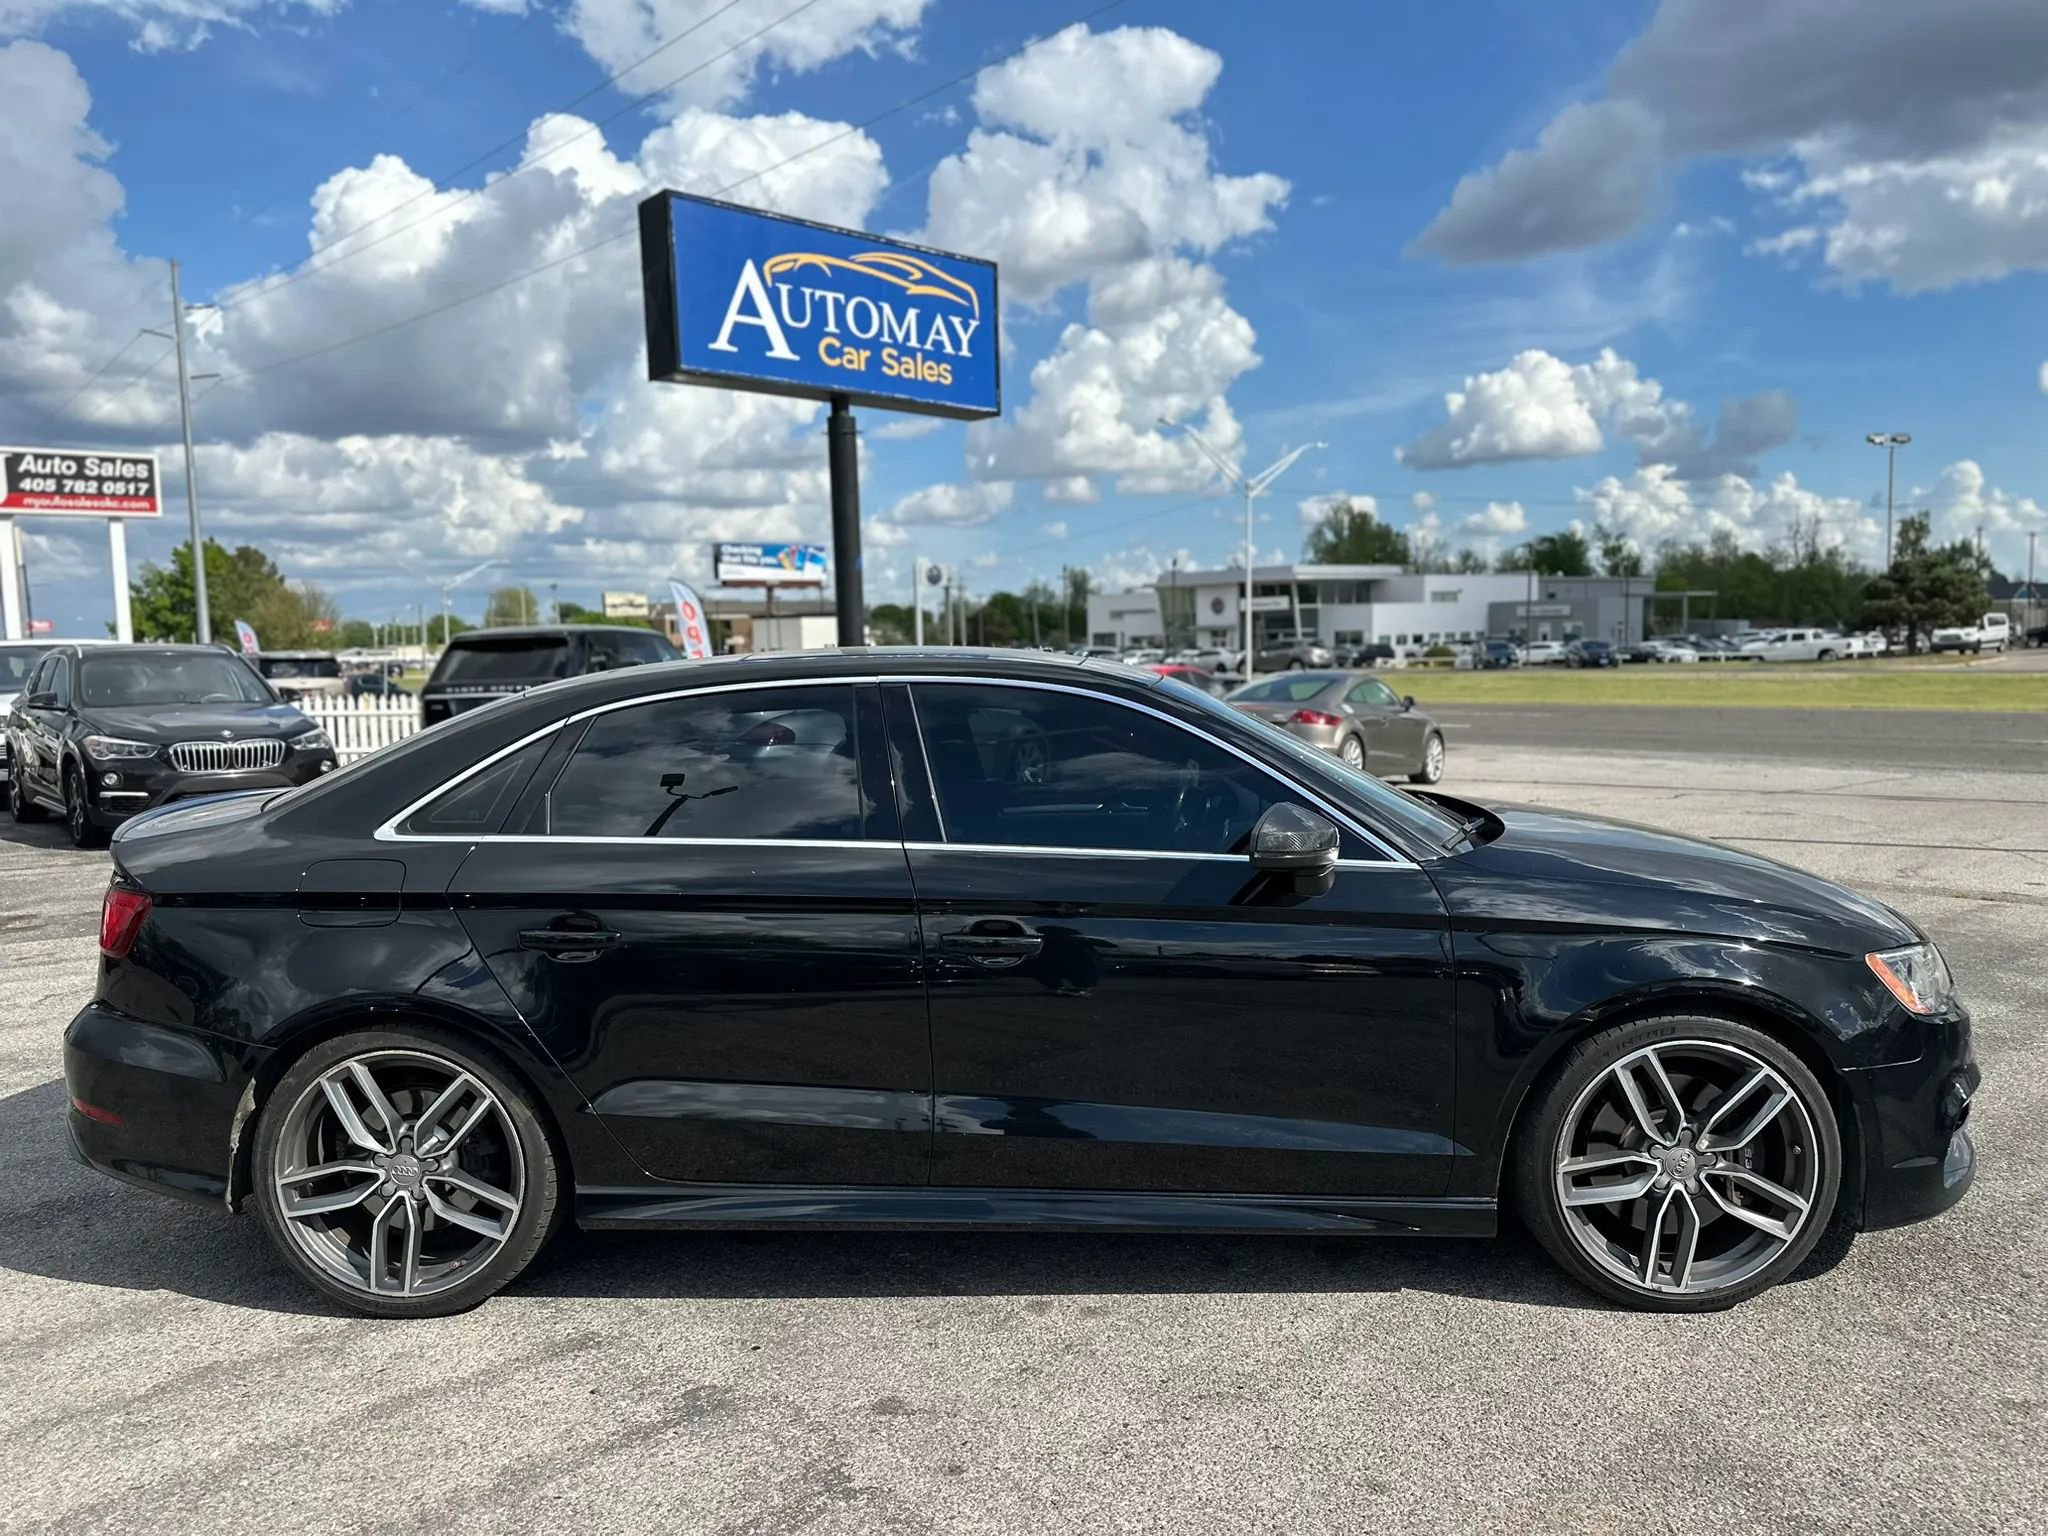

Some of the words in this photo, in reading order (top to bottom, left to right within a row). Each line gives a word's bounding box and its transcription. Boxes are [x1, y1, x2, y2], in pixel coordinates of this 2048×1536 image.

[708, 259, 980, 361] AUTOMAY
[818, 336, 871, 372] Car
[881, 347, 953, 385] Sales
[18, 454, 78, 475] Auto
[84, 457, 149, 479] Sales
[19, 477, 57, 492] 405
[102, 481, 149, 496] 0517
